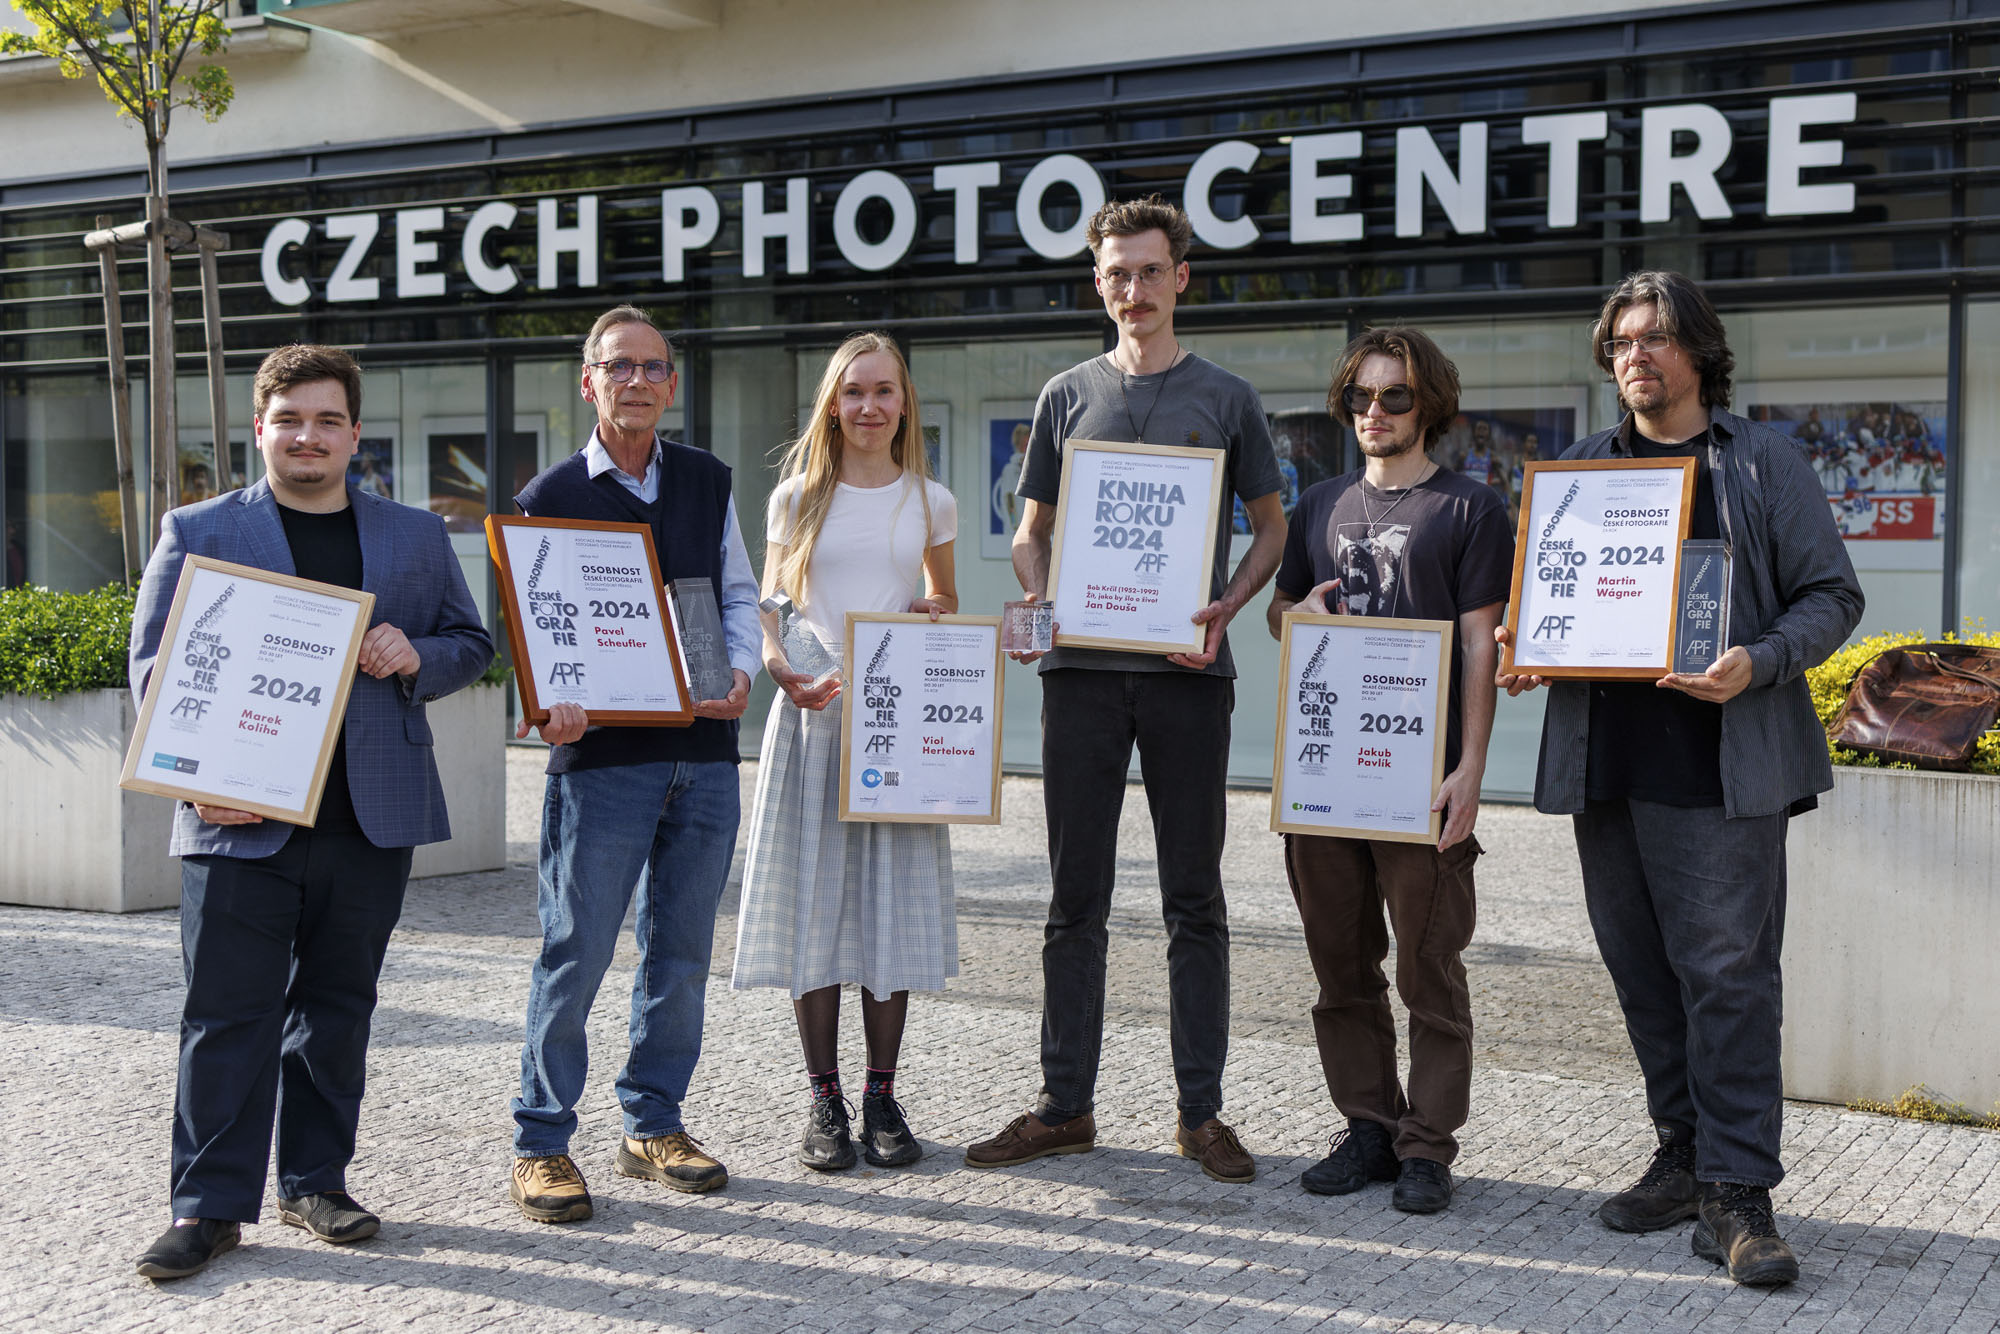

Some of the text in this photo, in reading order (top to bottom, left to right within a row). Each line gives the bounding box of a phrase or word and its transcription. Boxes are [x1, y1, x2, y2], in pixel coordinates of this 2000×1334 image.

[261, 92, 1857, 306] CZECH PHOTO CENTRE
[1098, 479, 1186, 505] KNIHA
[1095, 500, 1174, 527] ROKU
[1604, 508, 1670, 518] OSOBNOST
[1092, 525, 1164, 551] 2024
[1539, 538, 1574, 551] ČESKÉ
[1134, 552, 1169, 573] APF
[1536, 551, 1587, 567] FOTO
[1599, 546, 1665, 566] 2024
[581, 565, 641, 576] OSOBNOST
[1538, 566, 1578, 582] GRA
[583, 574, 603, 582] ČESKÉ
[1597, 576, 1636, 586] Martin
[528, 589, 562, 601] ČESKÉ
[1114, 593, 1123, 602] by
[1124, 594, 1134, 602] šlo
[1550, 583, 1575, 598] FIE
[1596, 588, 1643, 600] Wágner
[1687, 592, 1709, 600] ČESKÉ
[529, 601, 578, 617] FOTO
[588, 600, 651, 619] 2024
[1085, 601, 1137, 612] Jan Douša
[1686, 600, 1717, 610] FOTO
[1012, 615, 1042, 625] ROKU
[1687, 610, 1712, 619] GRA
[535, 616, 576, 630] GRA
[1532, 615, 1575, 640] APF
[1695, 620, 1711, 629] FIE
[190, 628, 222, 644] ČESKÉ
[594, 626, 625, 636] Pavel
[263, 633, 336, 656] OSOBNOST
[552, 632, 578, 647] FIE
[597, 638, 647, 648] Scheufler
[185, 639, 231, 660] FOTO
[1685, 640, 1712, 655] APF
[184, 653, 220, 672] GRA
[193, 670, 217, 685] FIE
[549, 662, 585, 685] APF
[925, 667, 986, 678] OSOBNOST
[177, 680, 218, 694] DO 30 LET
[864, 675, 891, 685] ČESKÉ
[1299, 680, 1327, 691] ČESKÉ
[1363, 674, 1427, 687] OSOBNOST
[248, 674, 322, 707] 2024
[864, 685, 902, 698] FOTO
[1298, 690, 1338, 704] FOTO
[170, 696, 212, 720] APF
[865, 697, 896, 709] GRA
[1300, 703, 1332, 717] GRA
[241, 709, 283, 725] Marek
[876, 710, 895, 721] FIE
[922, 704, 984, 724] 2024
[238, 720, 279, 736] Koliha
[1310, 717, 1330, 730] FIE
[1359, 712, 1424, 736] 2024
[864, 734, 896, 753] APF
[922, 736, 944, 745] Viol
[922, 746, 975, 756] Hertelová
[1298, 743, 1331, 763] APF
[1358, 747, 1392, 757] Jakub
[1357, 757, 1392, 768] Pavlík
[1303, 803, 1332, 813] FOMEI
